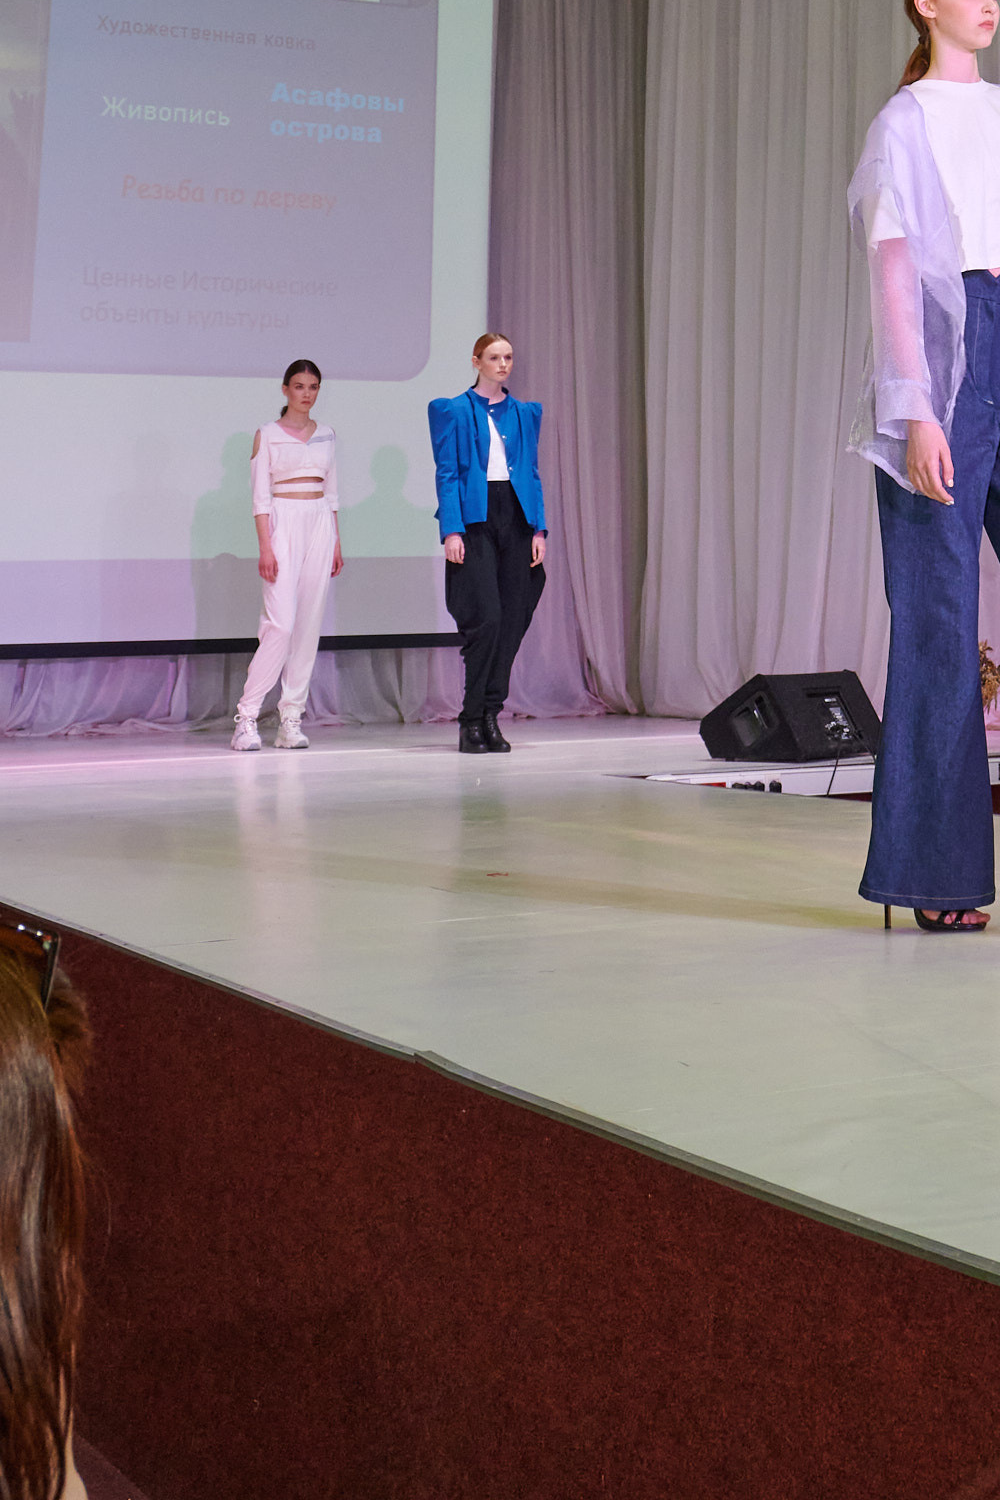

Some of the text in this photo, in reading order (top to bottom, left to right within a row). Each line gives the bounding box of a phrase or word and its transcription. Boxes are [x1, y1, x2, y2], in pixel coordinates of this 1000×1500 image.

[96, 14, 316, 51] Художественная ковка
[101, 95, 231, 127] Живопись
[270, 82, 405, 114] Асафовы
[269, 119, 383, 144] острова
[121, 174, 338, 216] Резьба по дереву
[82, 265, 339, 298] Ценные Исторические
[79, 301, 291, 332] объекты культуры
